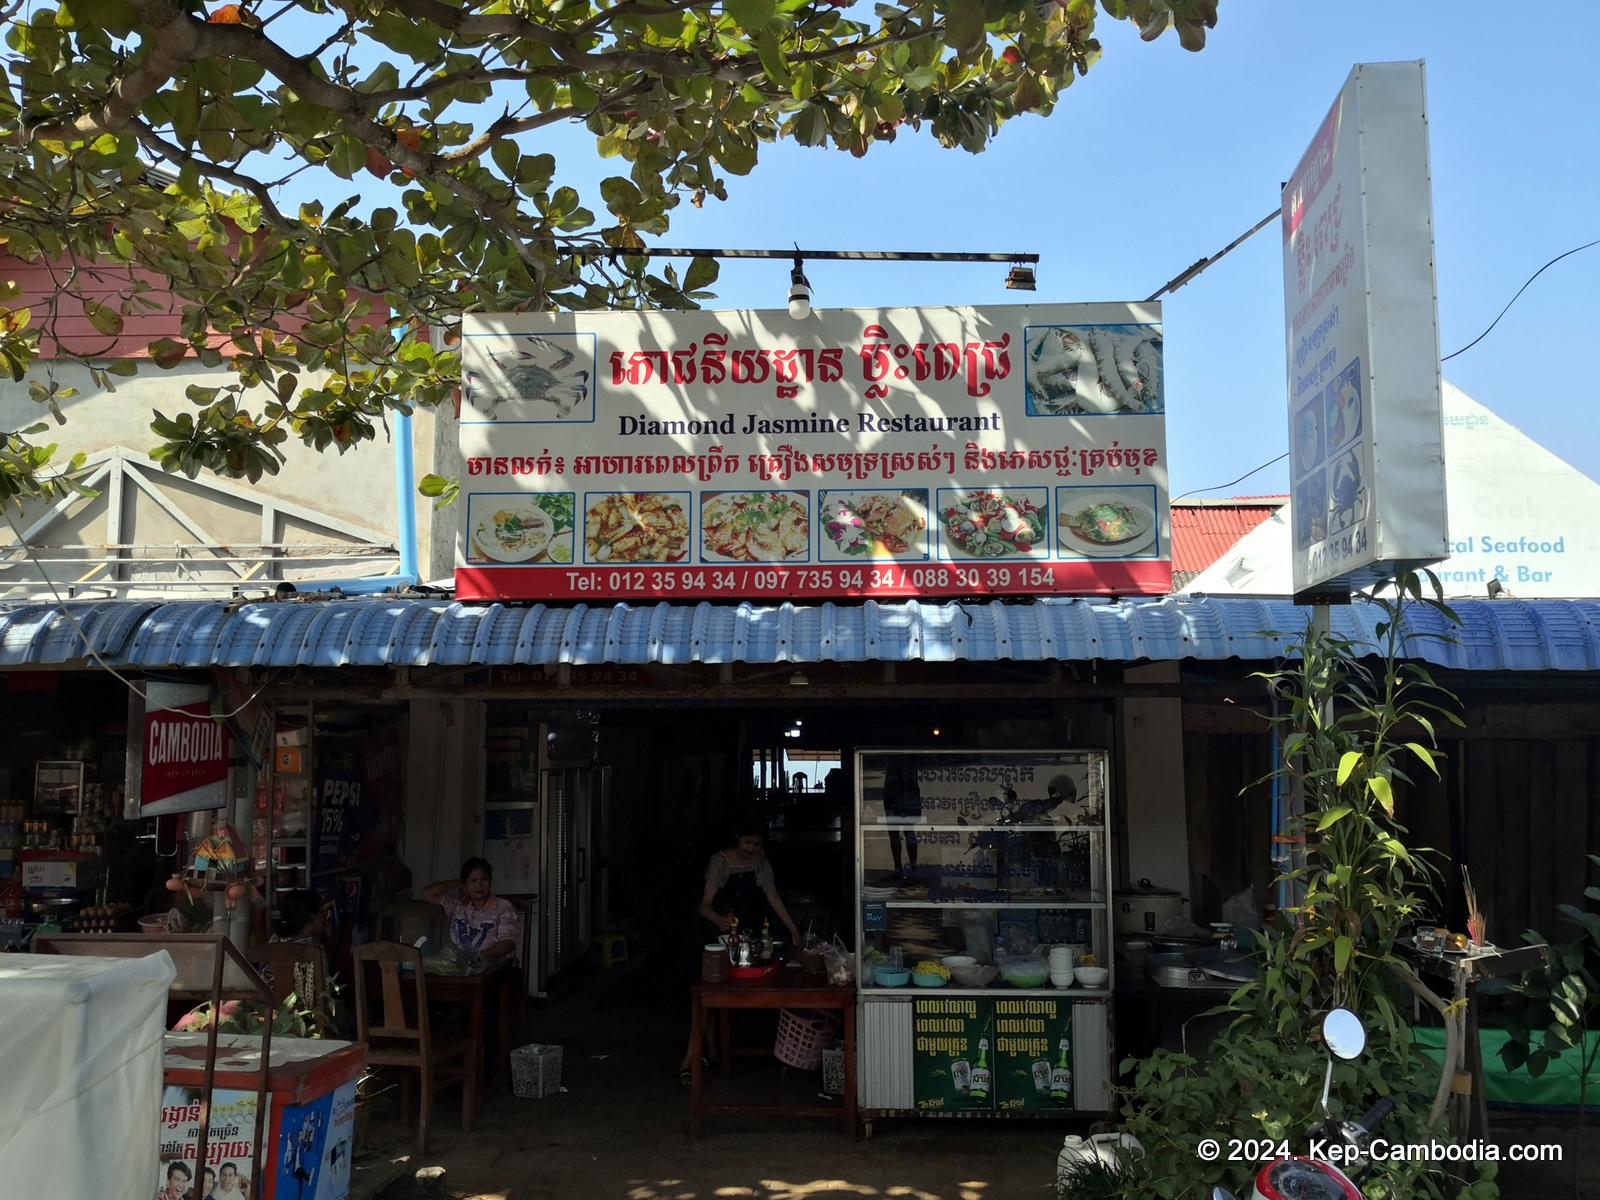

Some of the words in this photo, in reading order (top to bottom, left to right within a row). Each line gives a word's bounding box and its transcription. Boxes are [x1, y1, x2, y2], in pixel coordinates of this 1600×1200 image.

[618, 413, 735, 436] Diamond
[743, 412, 849, 435] Jasmine
[857, 411, 1001, 433] Restaurant
[1472, 495, 1544, 520] Crab
[1313, 547, 1327, 572] 012
[1329, 540, 1339, 566] 35
[1342, 534, 1353, 560] 94
[1356, 527, 1367, 554] 34
[1448, 536, 1474, 554] cal
[1481, 535, 1565, 554] Seafood
[566, 571, 602, 591] Tel:
[609, 571, 645, 590] 012
[652, 571, 676, 590] 35
[682, 571, 706, 590] 94
[712, 571, 736, 590] 34
[741, 571, 749, 590] /
[754, 570, 790, 590] 097
[796, 570, 833, 589] 735
[839, 570, 863, 589] 94
[870, 569, 894, 588] 34
[899, 569, 906, 588] /
[912, 569, 949, 588] 088
[955, 568, 980, 587] 30
[986, 568, 1011, 587] 39
[1018, 567, 1055, 587] 154
[1493, 564, 1509, 583] &
[1517, 565, 1553, 583] Bar
[499, 670, 526, 683] Tel:
[592, 670, 613, 683] 94
[618, 670, 638, 683] 34
[148, 718, 223, 767] CAMBODIA
[322, 778, 361, 807] PEPSI
[321, 807, 345, 833] 75%
